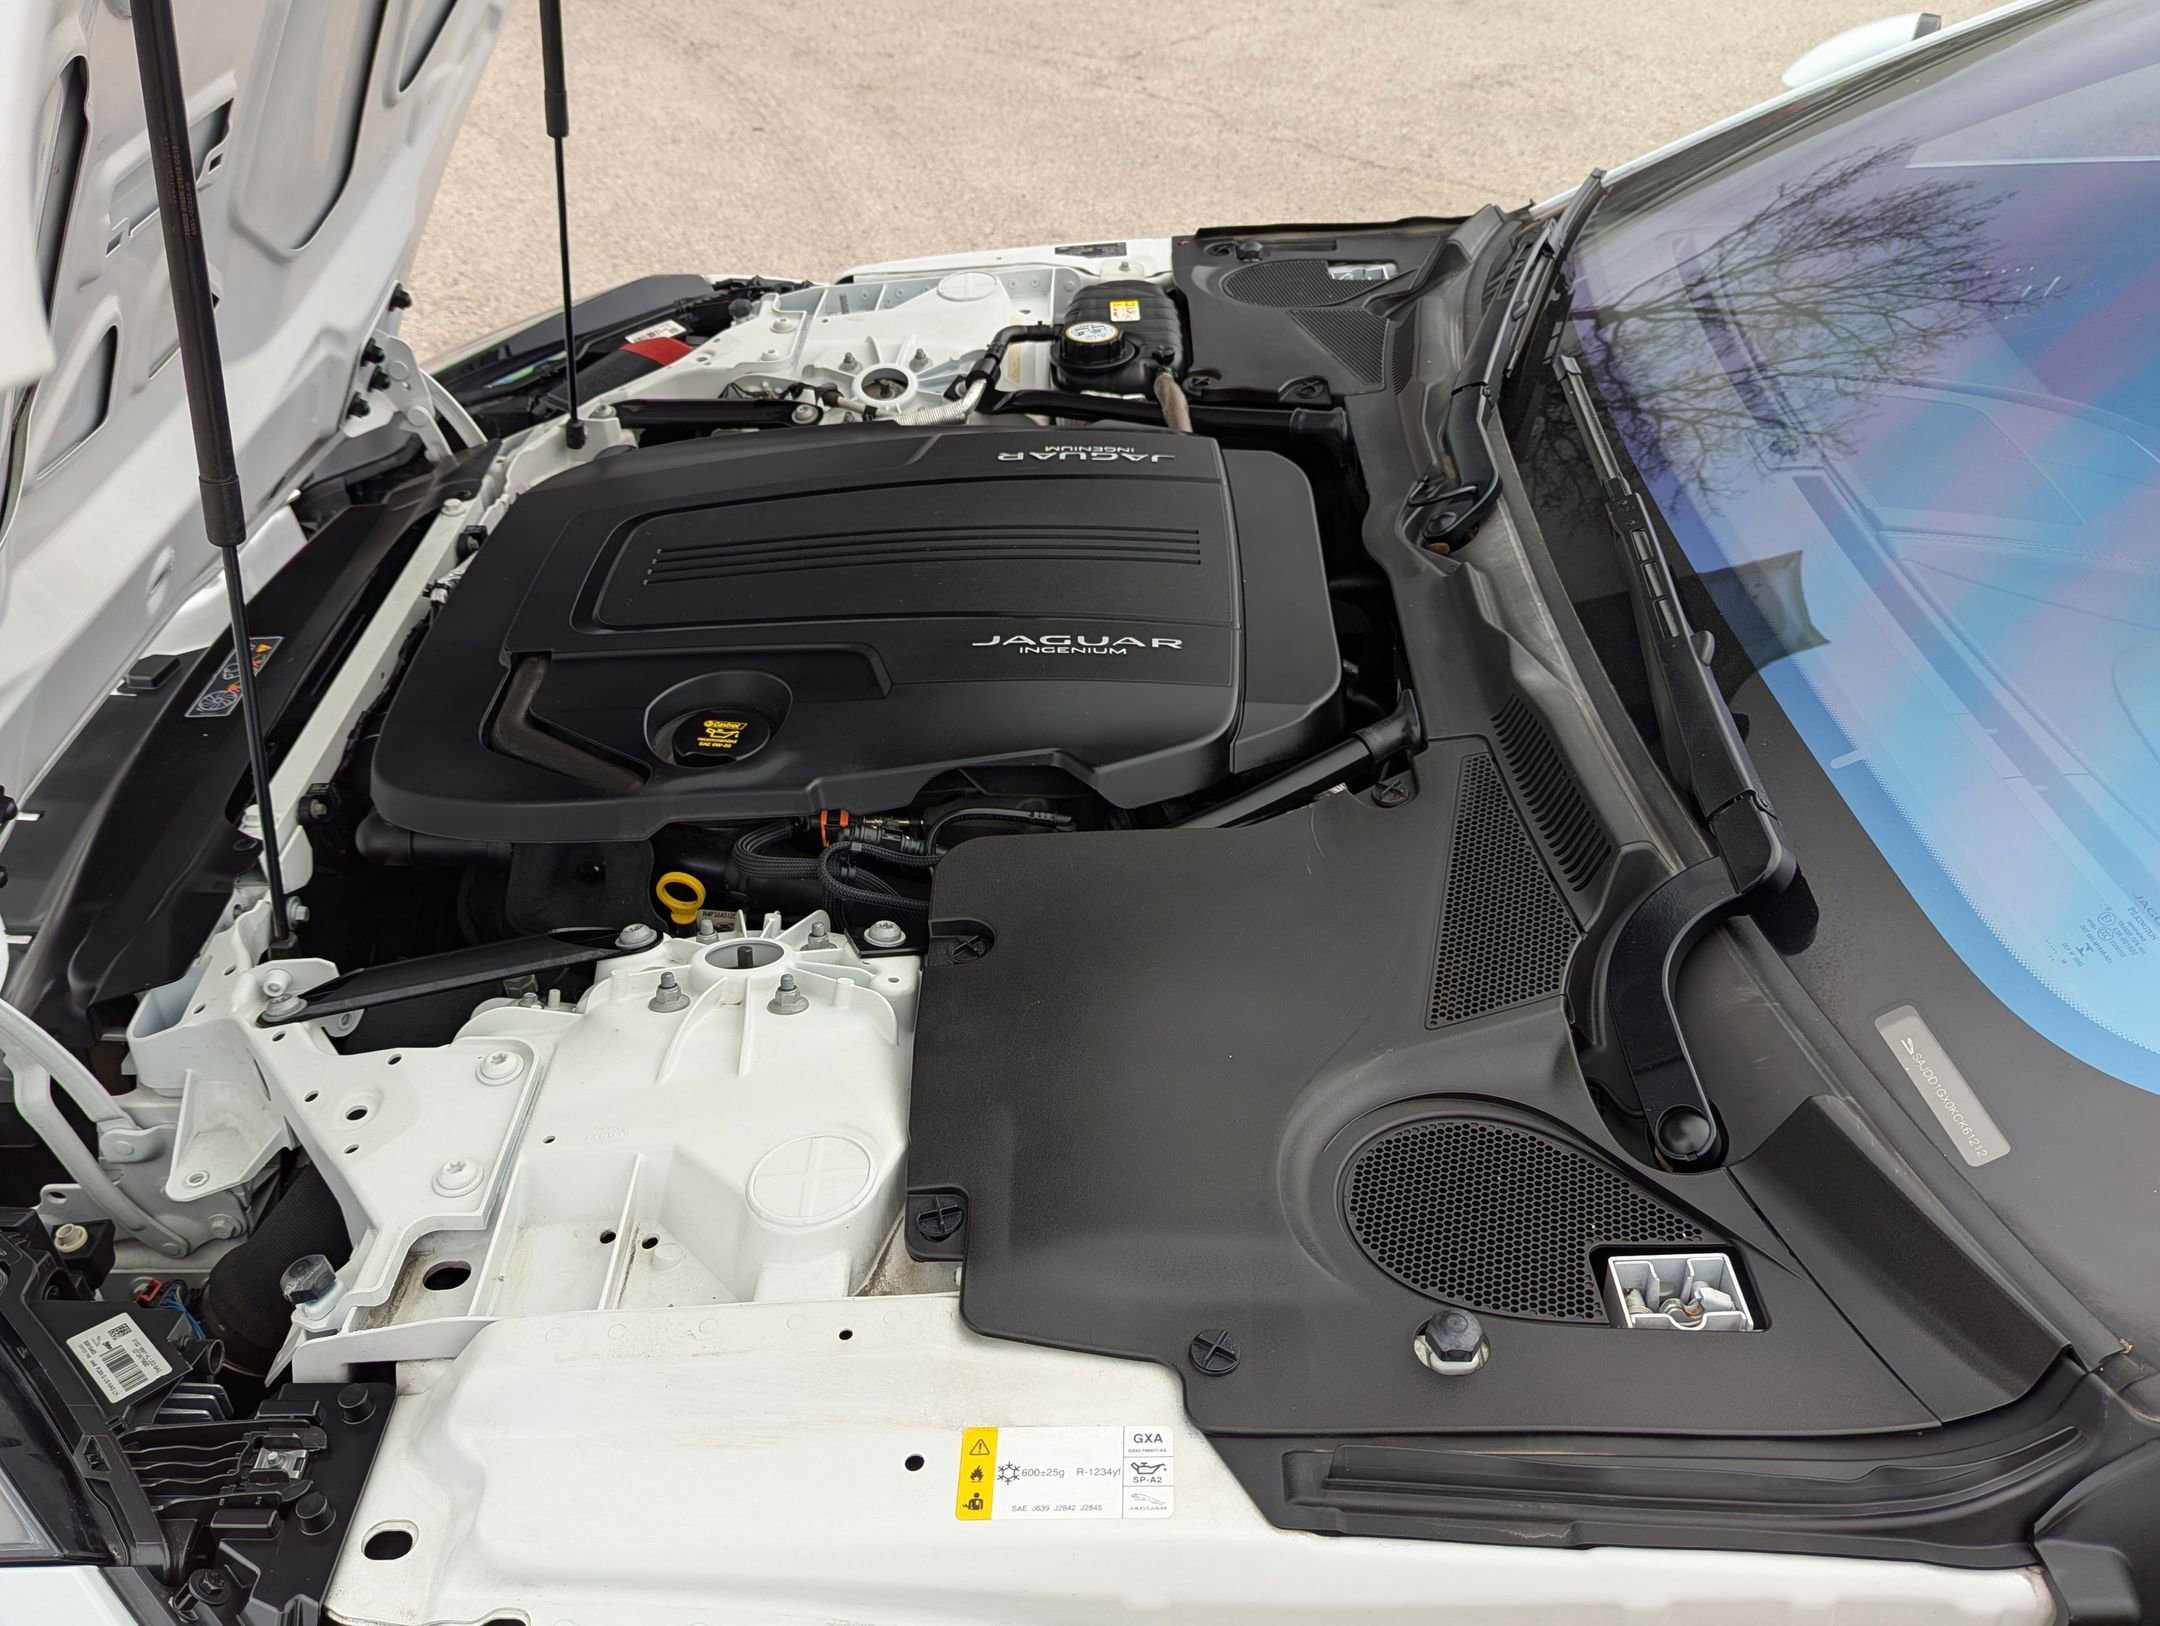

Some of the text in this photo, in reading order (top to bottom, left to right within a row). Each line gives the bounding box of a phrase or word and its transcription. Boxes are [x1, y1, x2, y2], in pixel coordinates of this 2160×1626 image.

[1045, 445, 1135, 453] INGENIUM
[997, 451, 1175, 463] JAGUAR
[972, 635, 1183, 649] JAGUAR
[1019, 646, 1127, 655] INGENIUM
[1912, 1052, 1988, 1158] SAJDD1GX0KCK61212
[1133, 1433, 1163, 1444] GXA
[1021, 1467, 1121, 1478] 600±25g R-1234yf
[1132, 1476, 1163, 1484] SP-A2
[1011, 1504, 1028, 1512] SAE
[1032, 1504, 1050, 1512] J639
[1053, 1504, 1076, 1512] J2842
